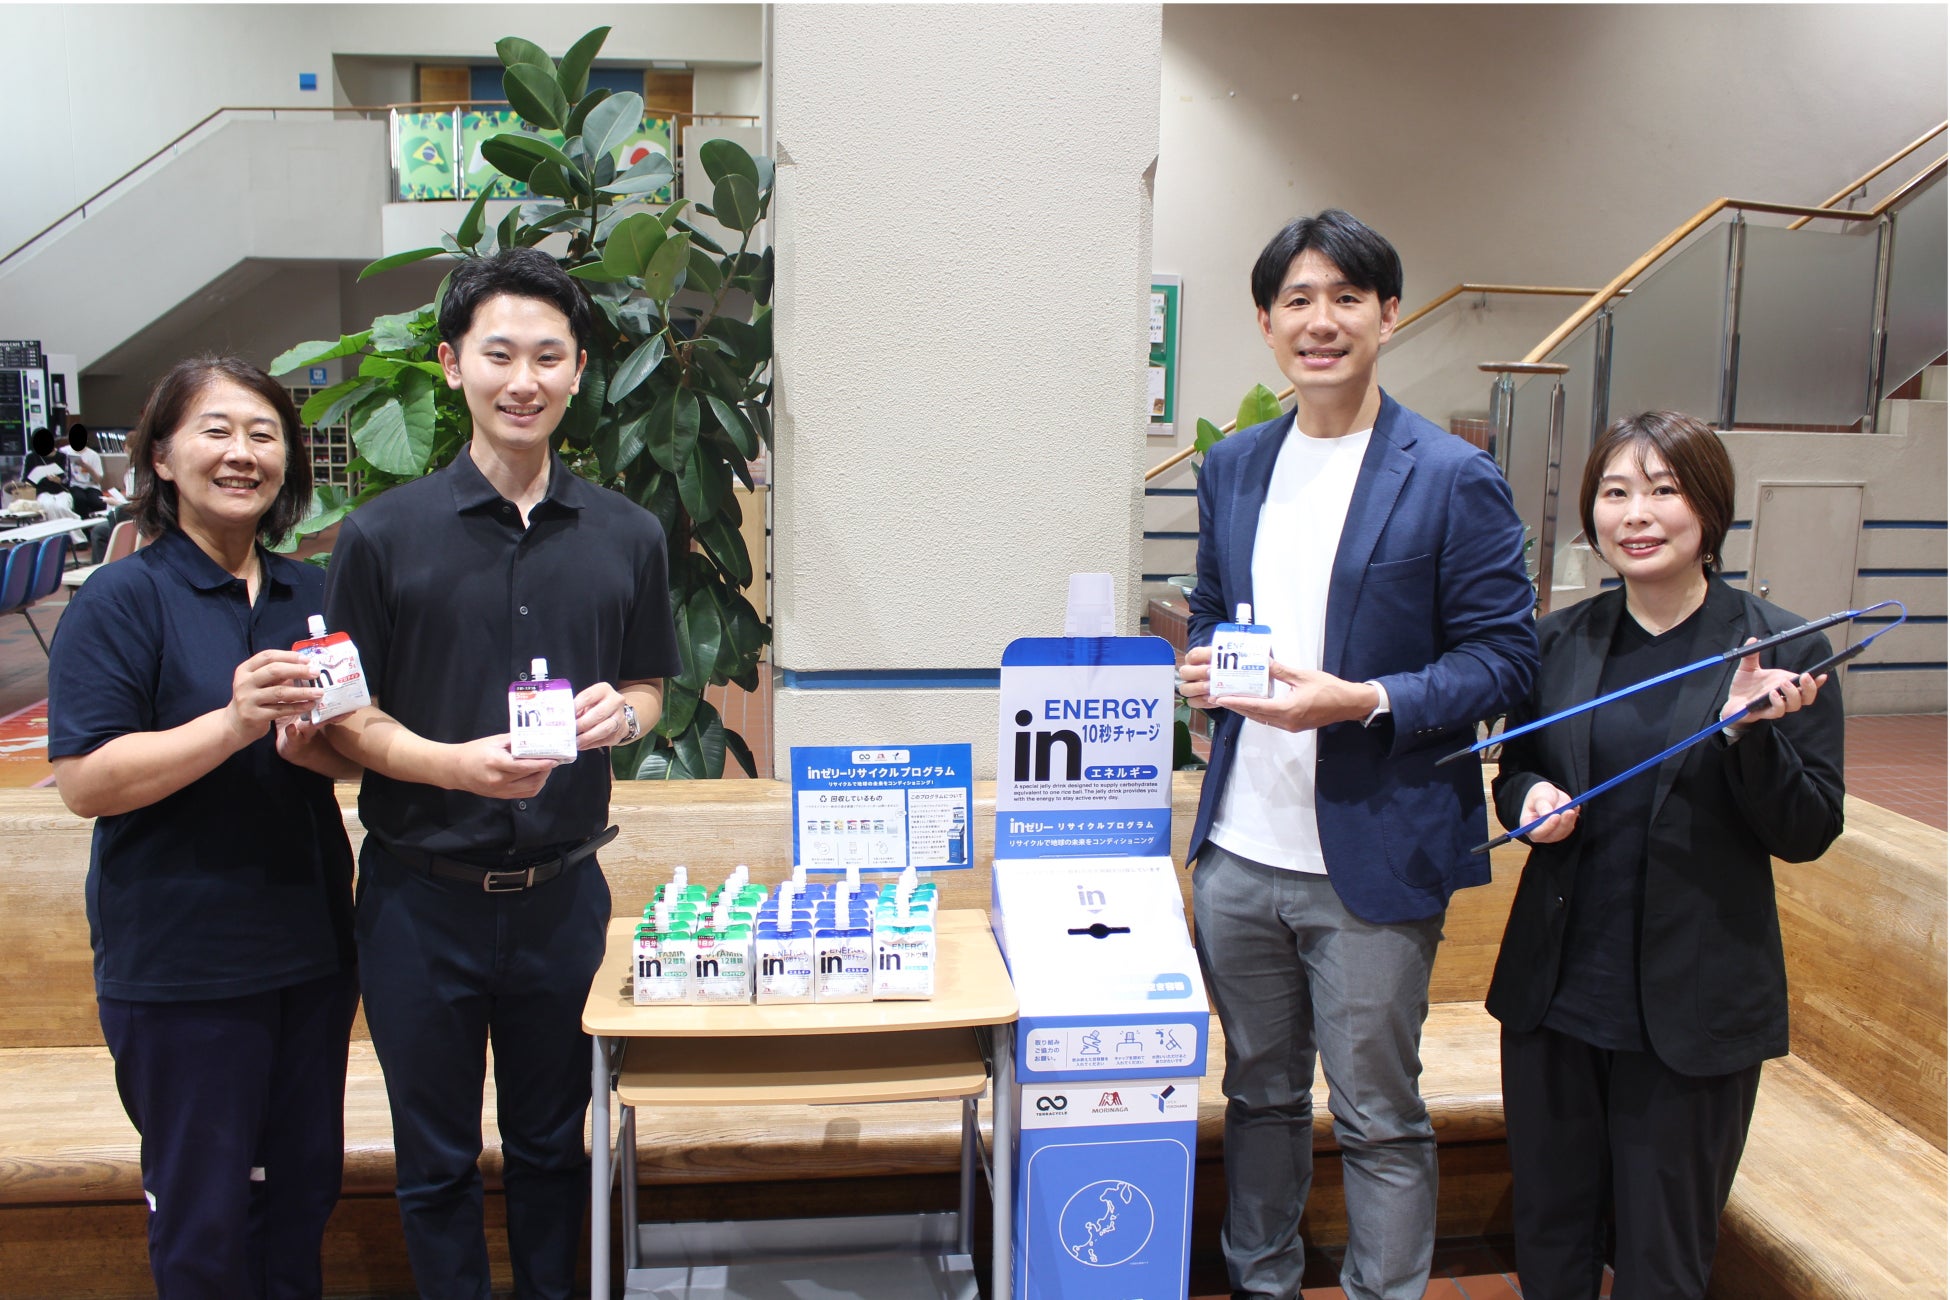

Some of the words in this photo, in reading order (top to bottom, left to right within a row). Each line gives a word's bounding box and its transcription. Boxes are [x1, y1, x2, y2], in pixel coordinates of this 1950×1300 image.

[1217, 645, 1239, 669] in
[516, 704, 542, 728] in
[1044, 698, 1159, 720] ENERGY
[1082, 723, 1161, 744] 10秒チャージ
[1014, 709, 1083, 782] in
[807, 766, 955, 779] inゼリーリサイクルプログラム
[1090, 766, 1152, 779] エネルギー
[830, 794, 882, 802] 回収しているもの
[910, 792, 963, 800] このプログラムについて
[1009, 818, 1053, 834] inゼリー
[1057, 820, 1154, 831] リサイクルプログラム
[1009, 836, 1154, 847] リサイクルで地球の未来をコンディショニング
[1076, 885, 1106, 906] in
[638, 954, 661, 977] in
[695, 954, 718, 977] in
[763, 953, 784, 976] in
[821, 950, 843, 974] in
[880, 946, 901, 970] in
[1091, 1106, 1129, 1114] MORINAGA
